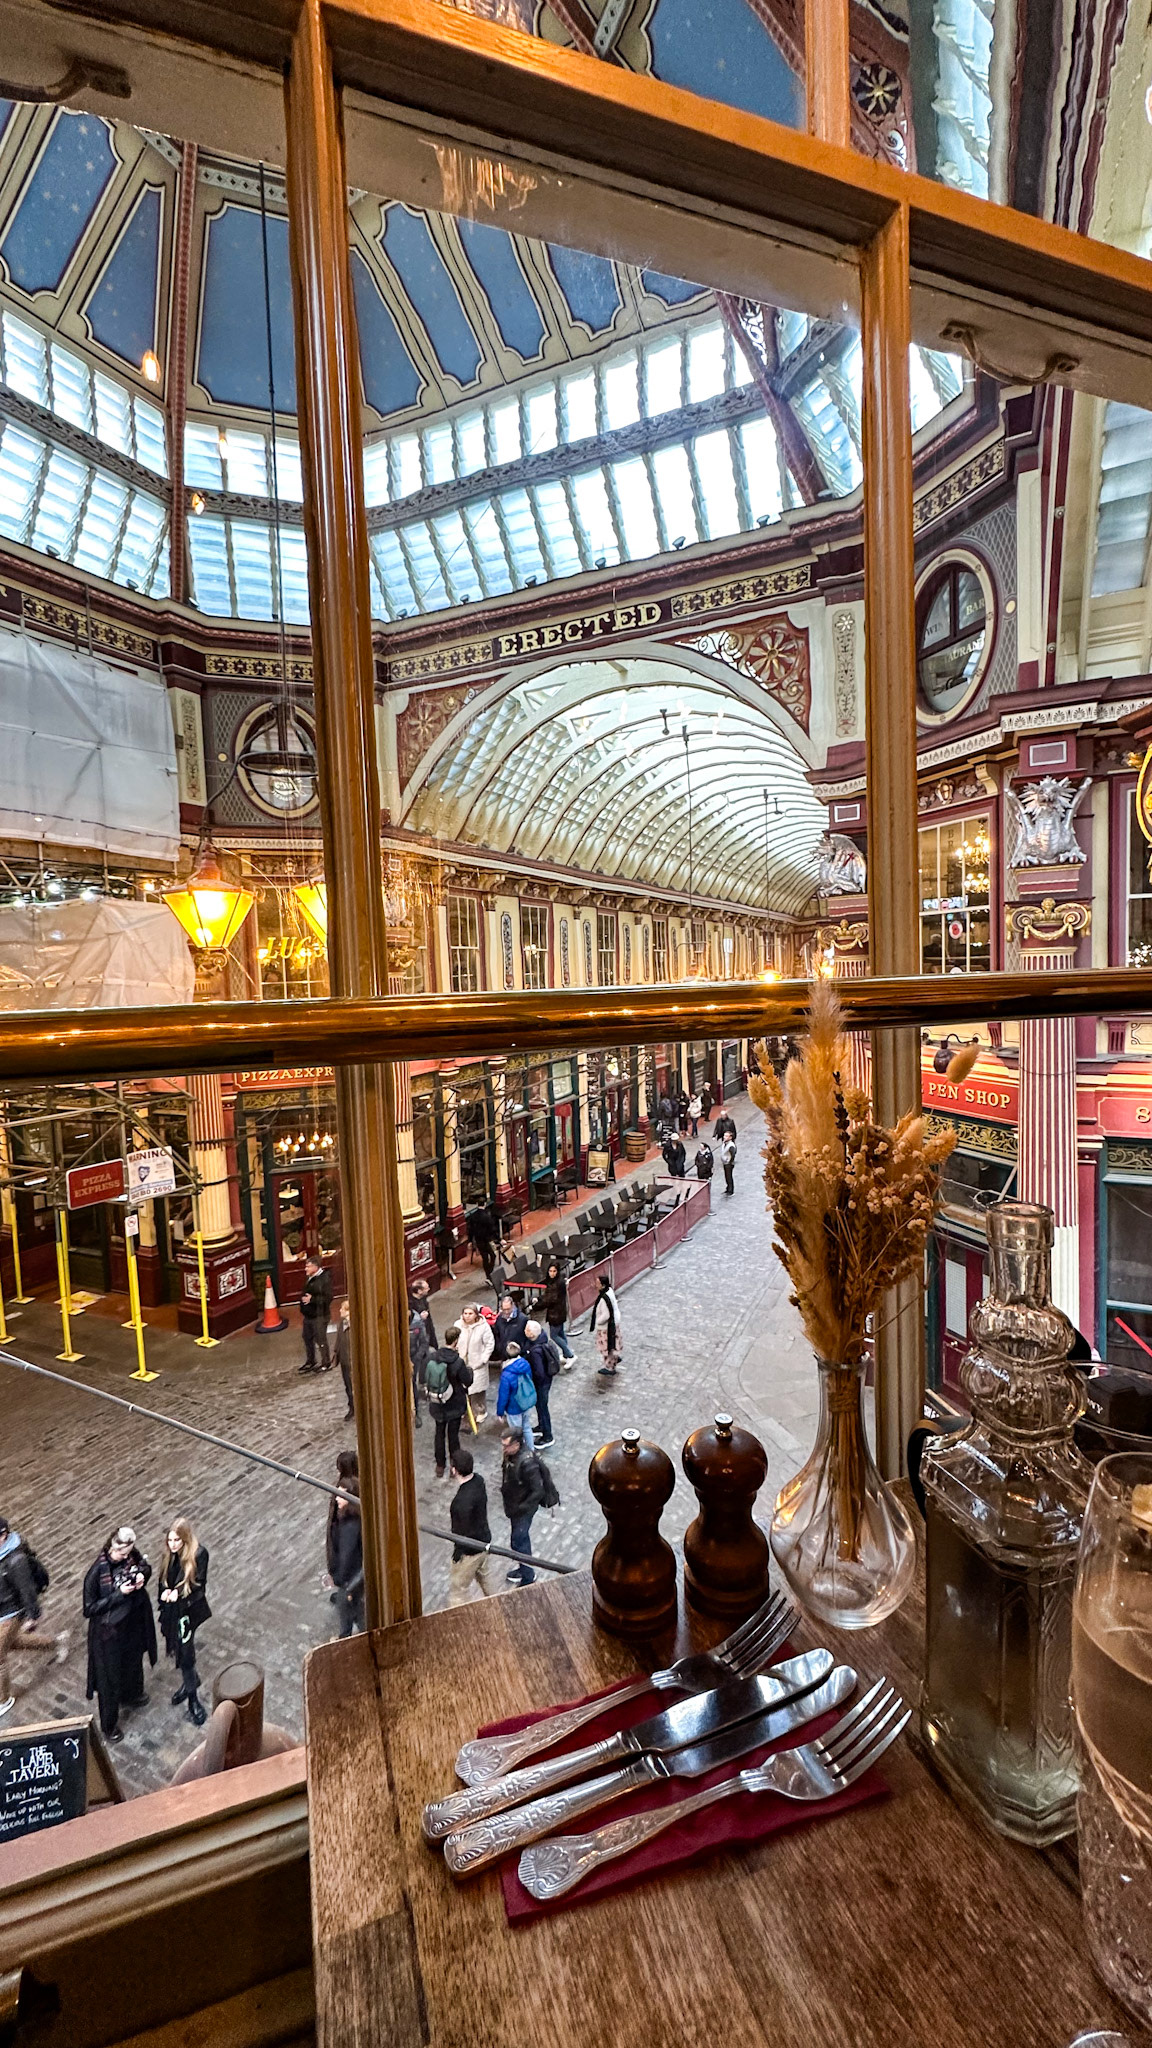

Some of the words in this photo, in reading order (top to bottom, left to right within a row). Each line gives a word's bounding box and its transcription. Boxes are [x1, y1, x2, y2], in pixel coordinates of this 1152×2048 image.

[498, 602, 662, 657] ERECTED
[241, 1066, 334, 1082] PIZZAEXPR
[928, 1082, 959, 1100] PEN
[964, 1088, 1011, 1109] SHOP
[74, 1179, 121, 1198] EXPRESS
[82, 1172, 112, 1187] PIZZA
[20, 1751, 54, 1770] LAMB
[29, 1745, 48, 1757] THE
[6, 1763, 60, 1786] TAVERN
